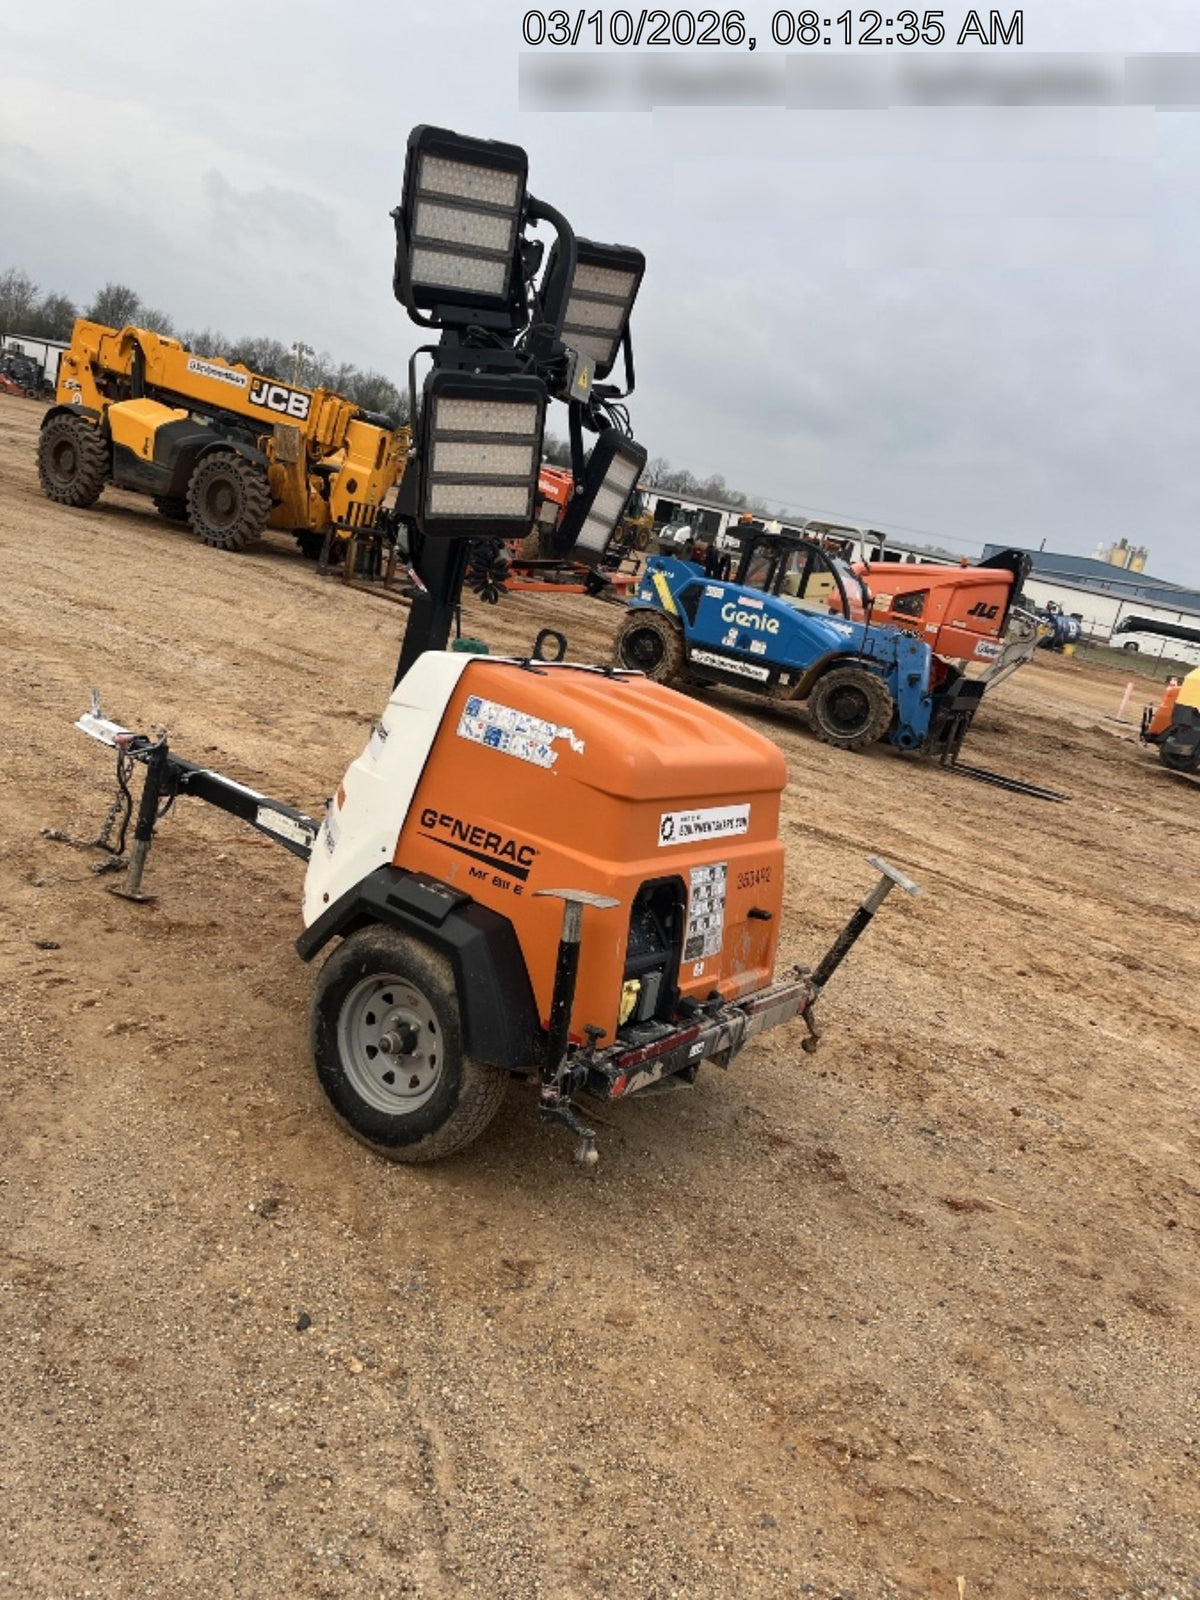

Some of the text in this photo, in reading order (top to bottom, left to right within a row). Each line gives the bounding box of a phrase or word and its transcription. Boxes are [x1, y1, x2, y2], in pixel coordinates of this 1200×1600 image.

[250, 383, 310, 419] JCB
[721, 602, 780, 634] Genie
[967, 601, 999, 620] JLG
[420, 808, 536, 867] GENERAC
